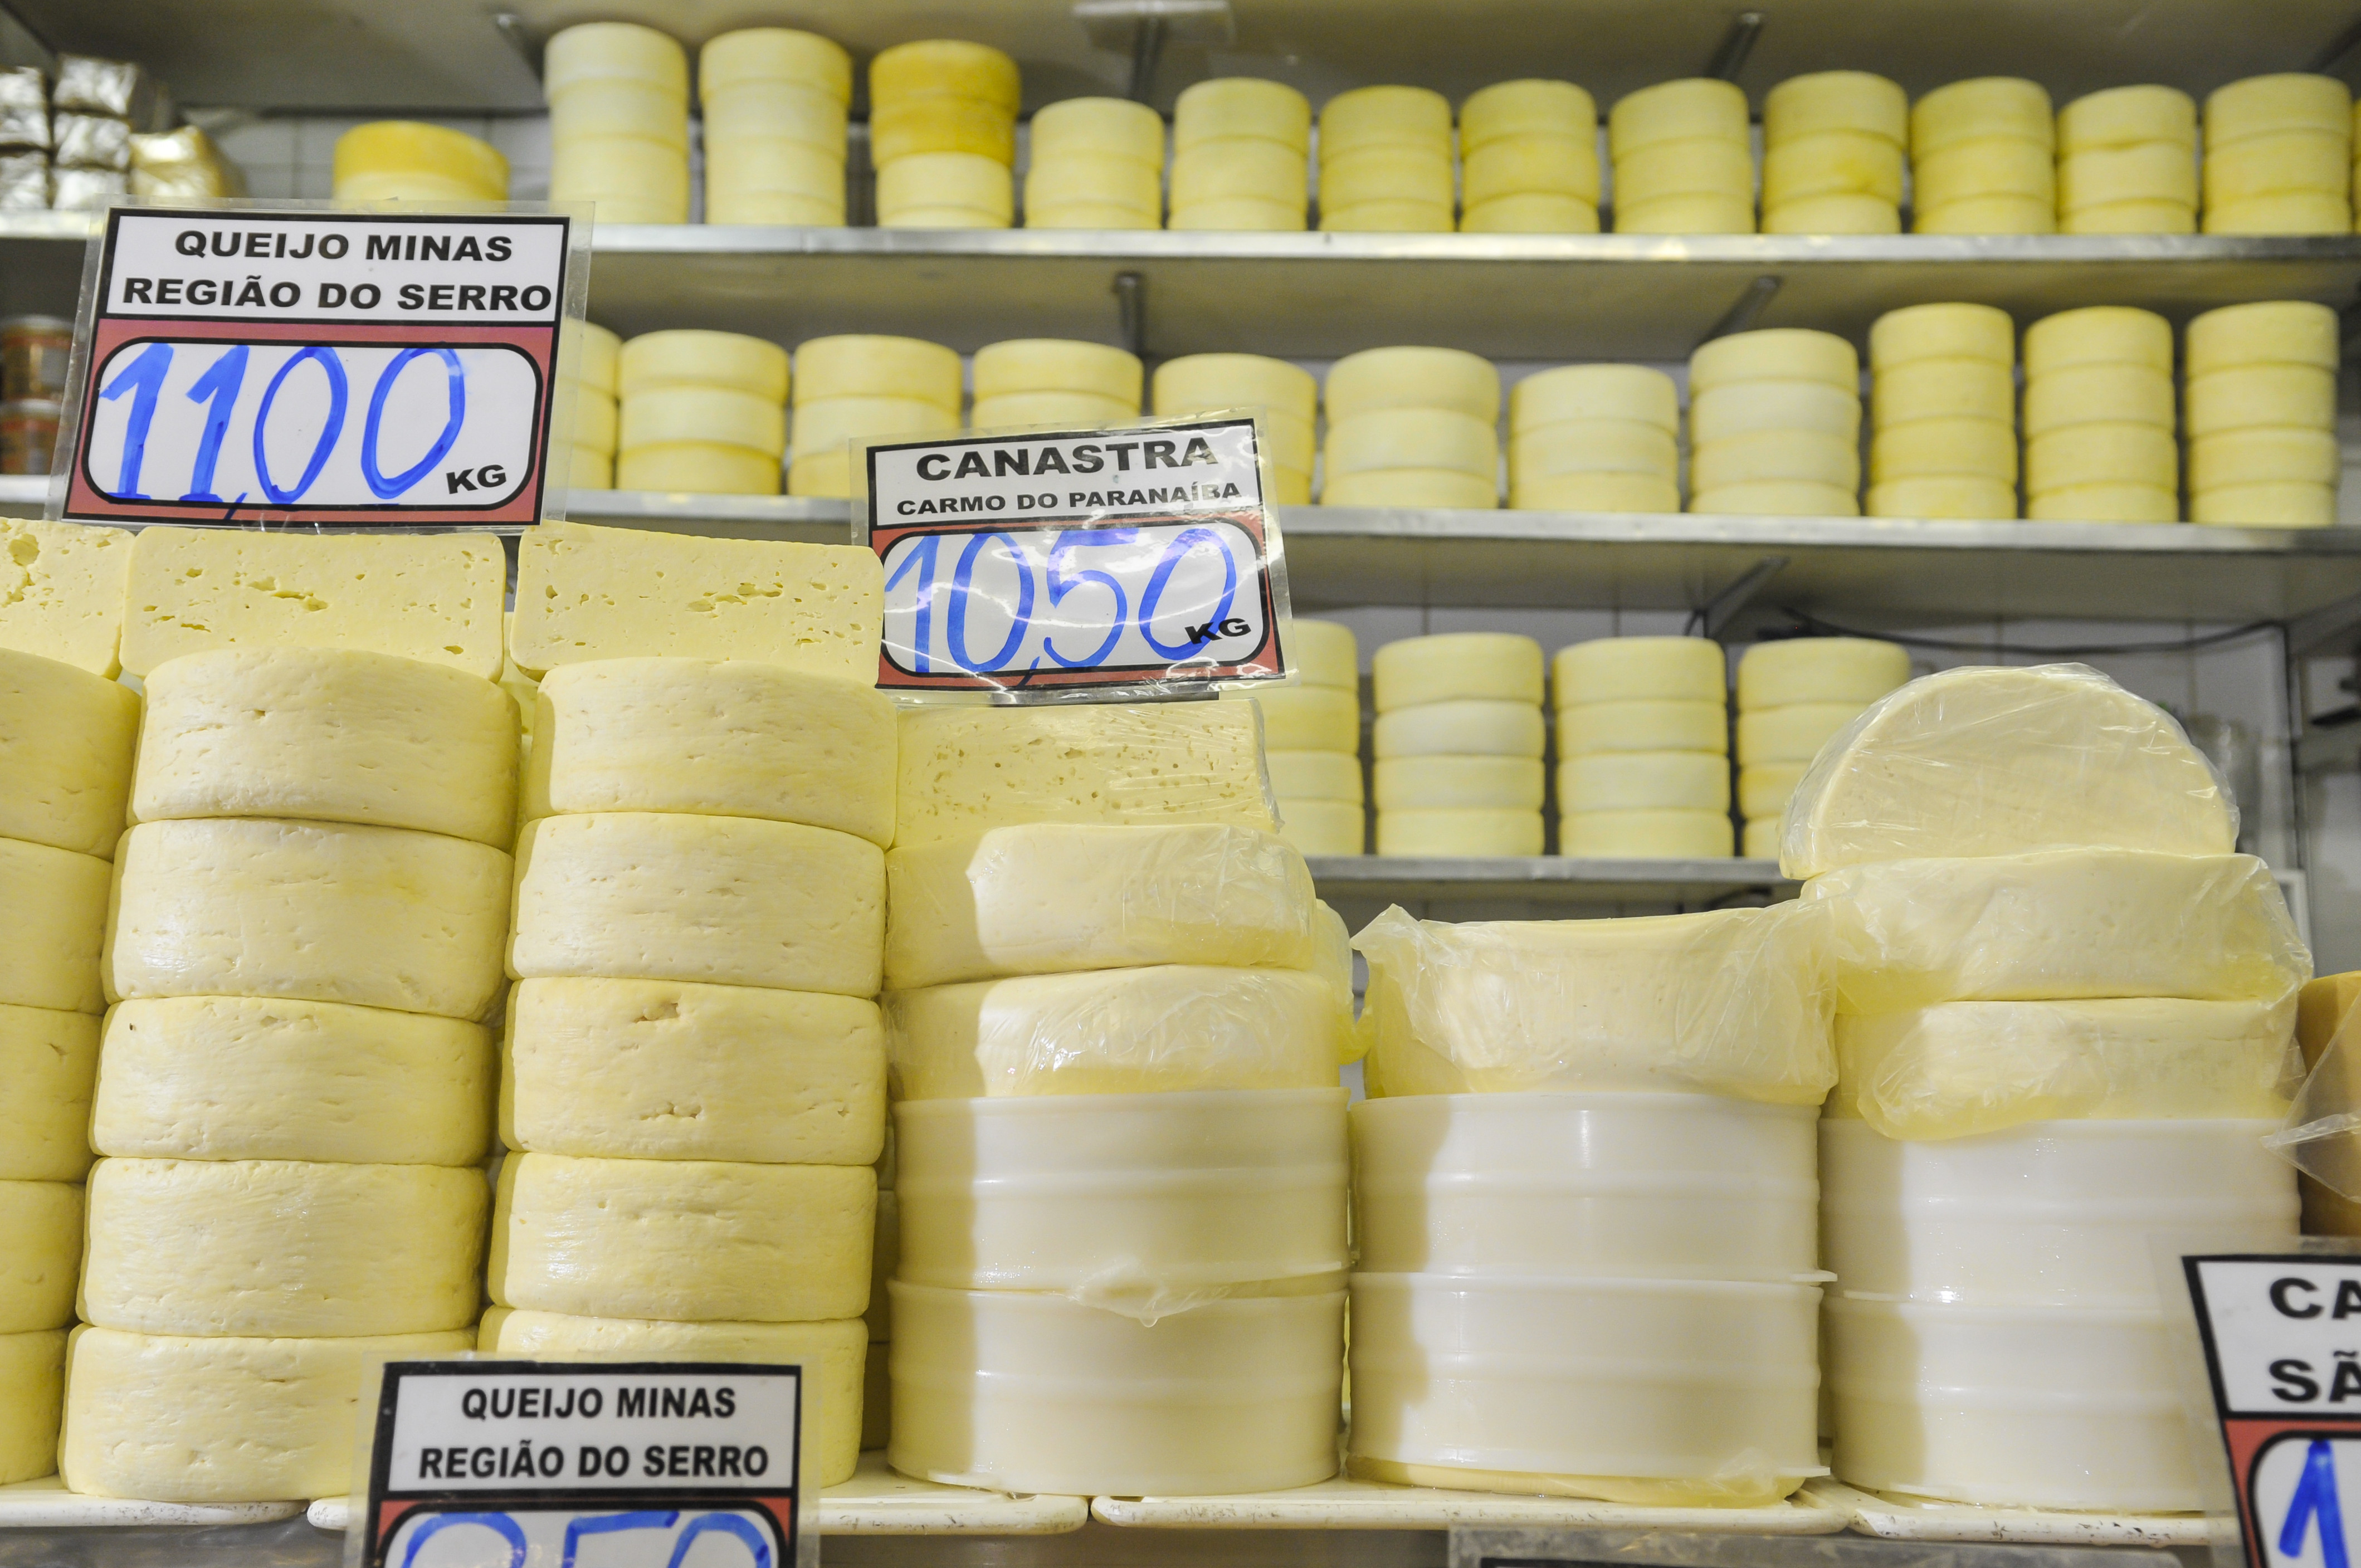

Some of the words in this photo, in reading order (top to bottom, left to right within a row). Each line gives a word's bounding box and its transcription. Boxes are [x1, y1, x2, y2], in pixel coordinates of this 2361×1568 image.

[175, 230, 349, 260] QUEIJO
[365, 235, 513, 262] MINAS
[123, 274, 301, 308] REGIÃO
[318, 282, 382, 310] DO
[397, 284, 552, 312] SERRO
[916, 437, 1219, 481] CANASTRA
[446, 464, 507, 495] KG
[896, 495, 1006, 516] CARMO
[1017, 492, 1058, 511] DO
[1069, 481, 1243, 508] PARANAÍBA
[1185, 617, 1252, 645] KG
[461, 1387, 603, 1422] QUEIJO
[616, 1386, 736, 1419] MINAS
[418, 1439, 565, 1479] REGIÃO
[577, 1445, 631, 1478] DO
[642, 1444, 769, 1478] SERRO
